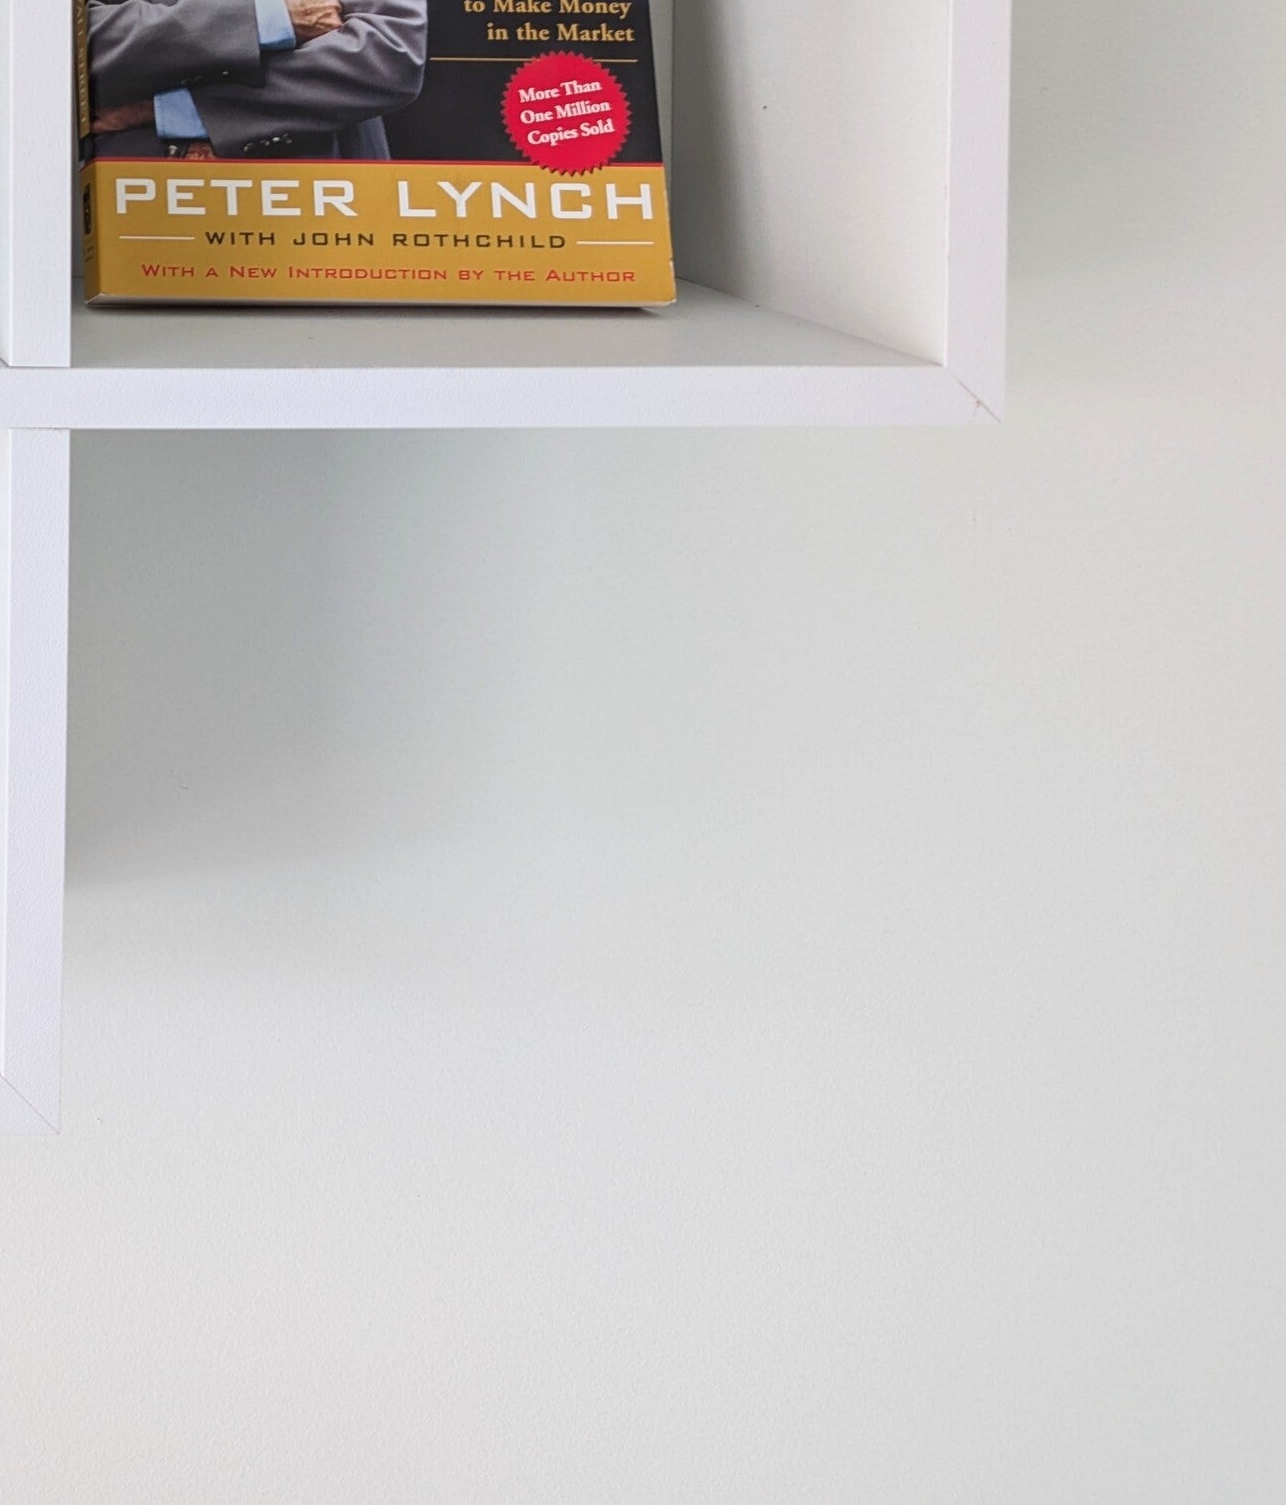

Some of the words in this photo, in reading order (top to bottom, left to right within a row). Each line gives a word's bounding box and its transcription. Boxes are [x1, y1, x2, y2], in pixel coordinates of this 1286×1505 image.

[487, 22, 508, 41] in
[516, 22, 550, 41] the
[556, 23, 635, 42] Market
[518, 87, 560, 103] More
[560, 80, 602, 96] Than
[520, 109, 554, 124] One
[554, 100, 612, 119] Million
[527, 126, 579, 146] Copies
[579, 118, 615, 137] Sold
[115, 178, 358, 217] PETER
[397, 181, 653, 220] LYNCH
[205, 231, 275, 246] WITH
[293, 232, 374, 246] JOHN
[392, 233, 566, 249] ROTHCHILD
[141, 264, 195, 278] WITH
[205, 267, 219, 278] A
[230, 265, 277, 279] NEW
[288, 266, 447, 280] INTRODUCTION
[458, 269, 484, 281] BY
[494, 270, 536, 282] THE
[545, 269, 636, 282] AUTHOR
